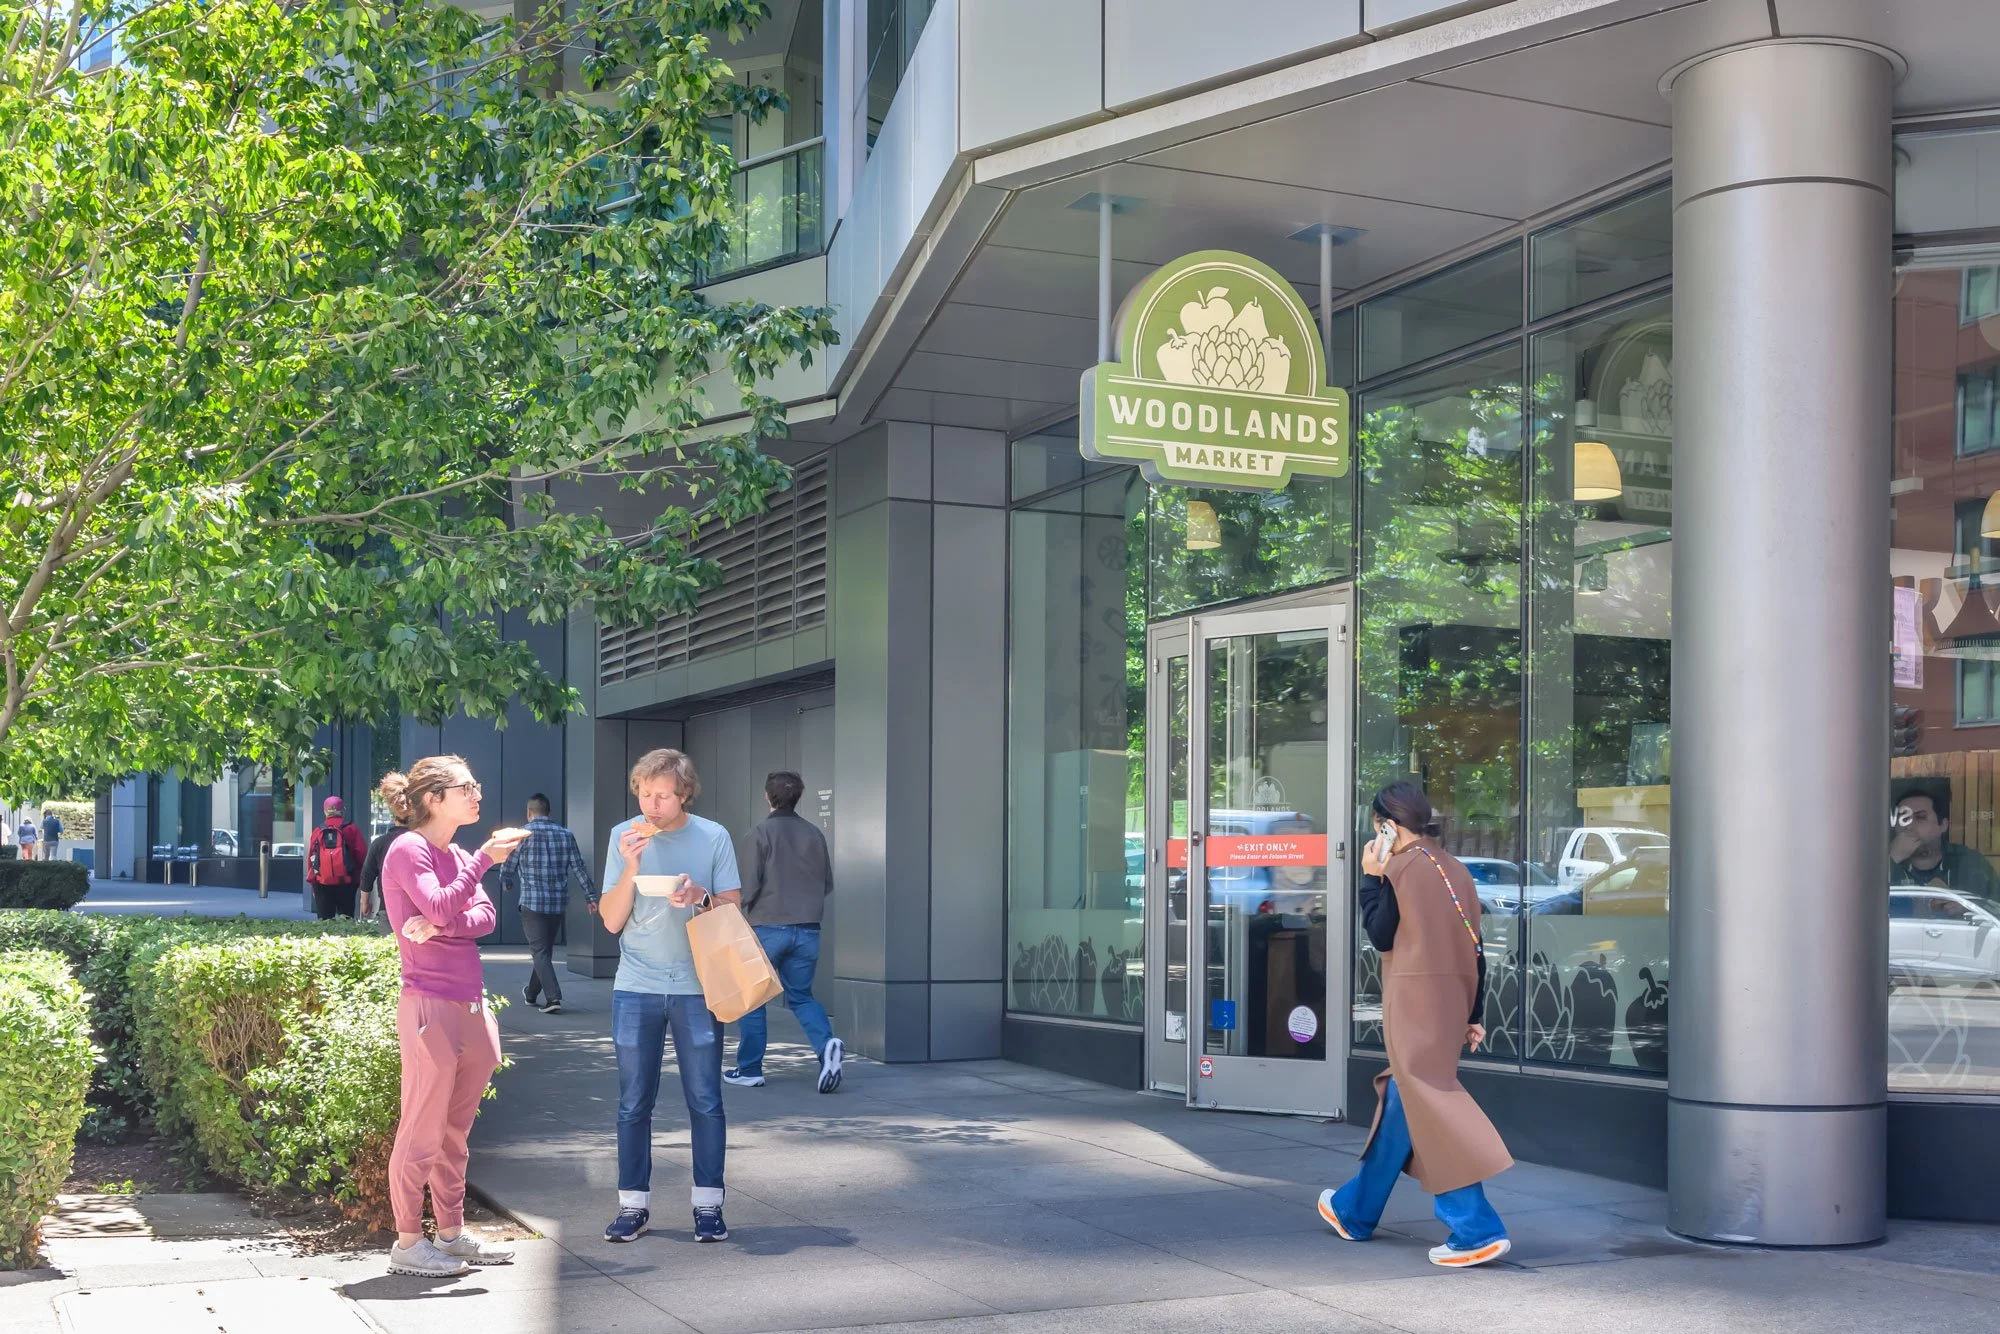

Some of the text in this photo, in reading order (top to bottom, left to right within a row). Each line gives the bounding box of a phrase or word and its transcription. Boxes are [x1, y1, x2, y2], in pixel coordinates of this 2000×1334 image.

[1108, 394, 1339, 446] WOODLANDS
[1175, 446, 1274, 472] MARKET
[1244, 843, 1289, 852] EXIT ONLY
